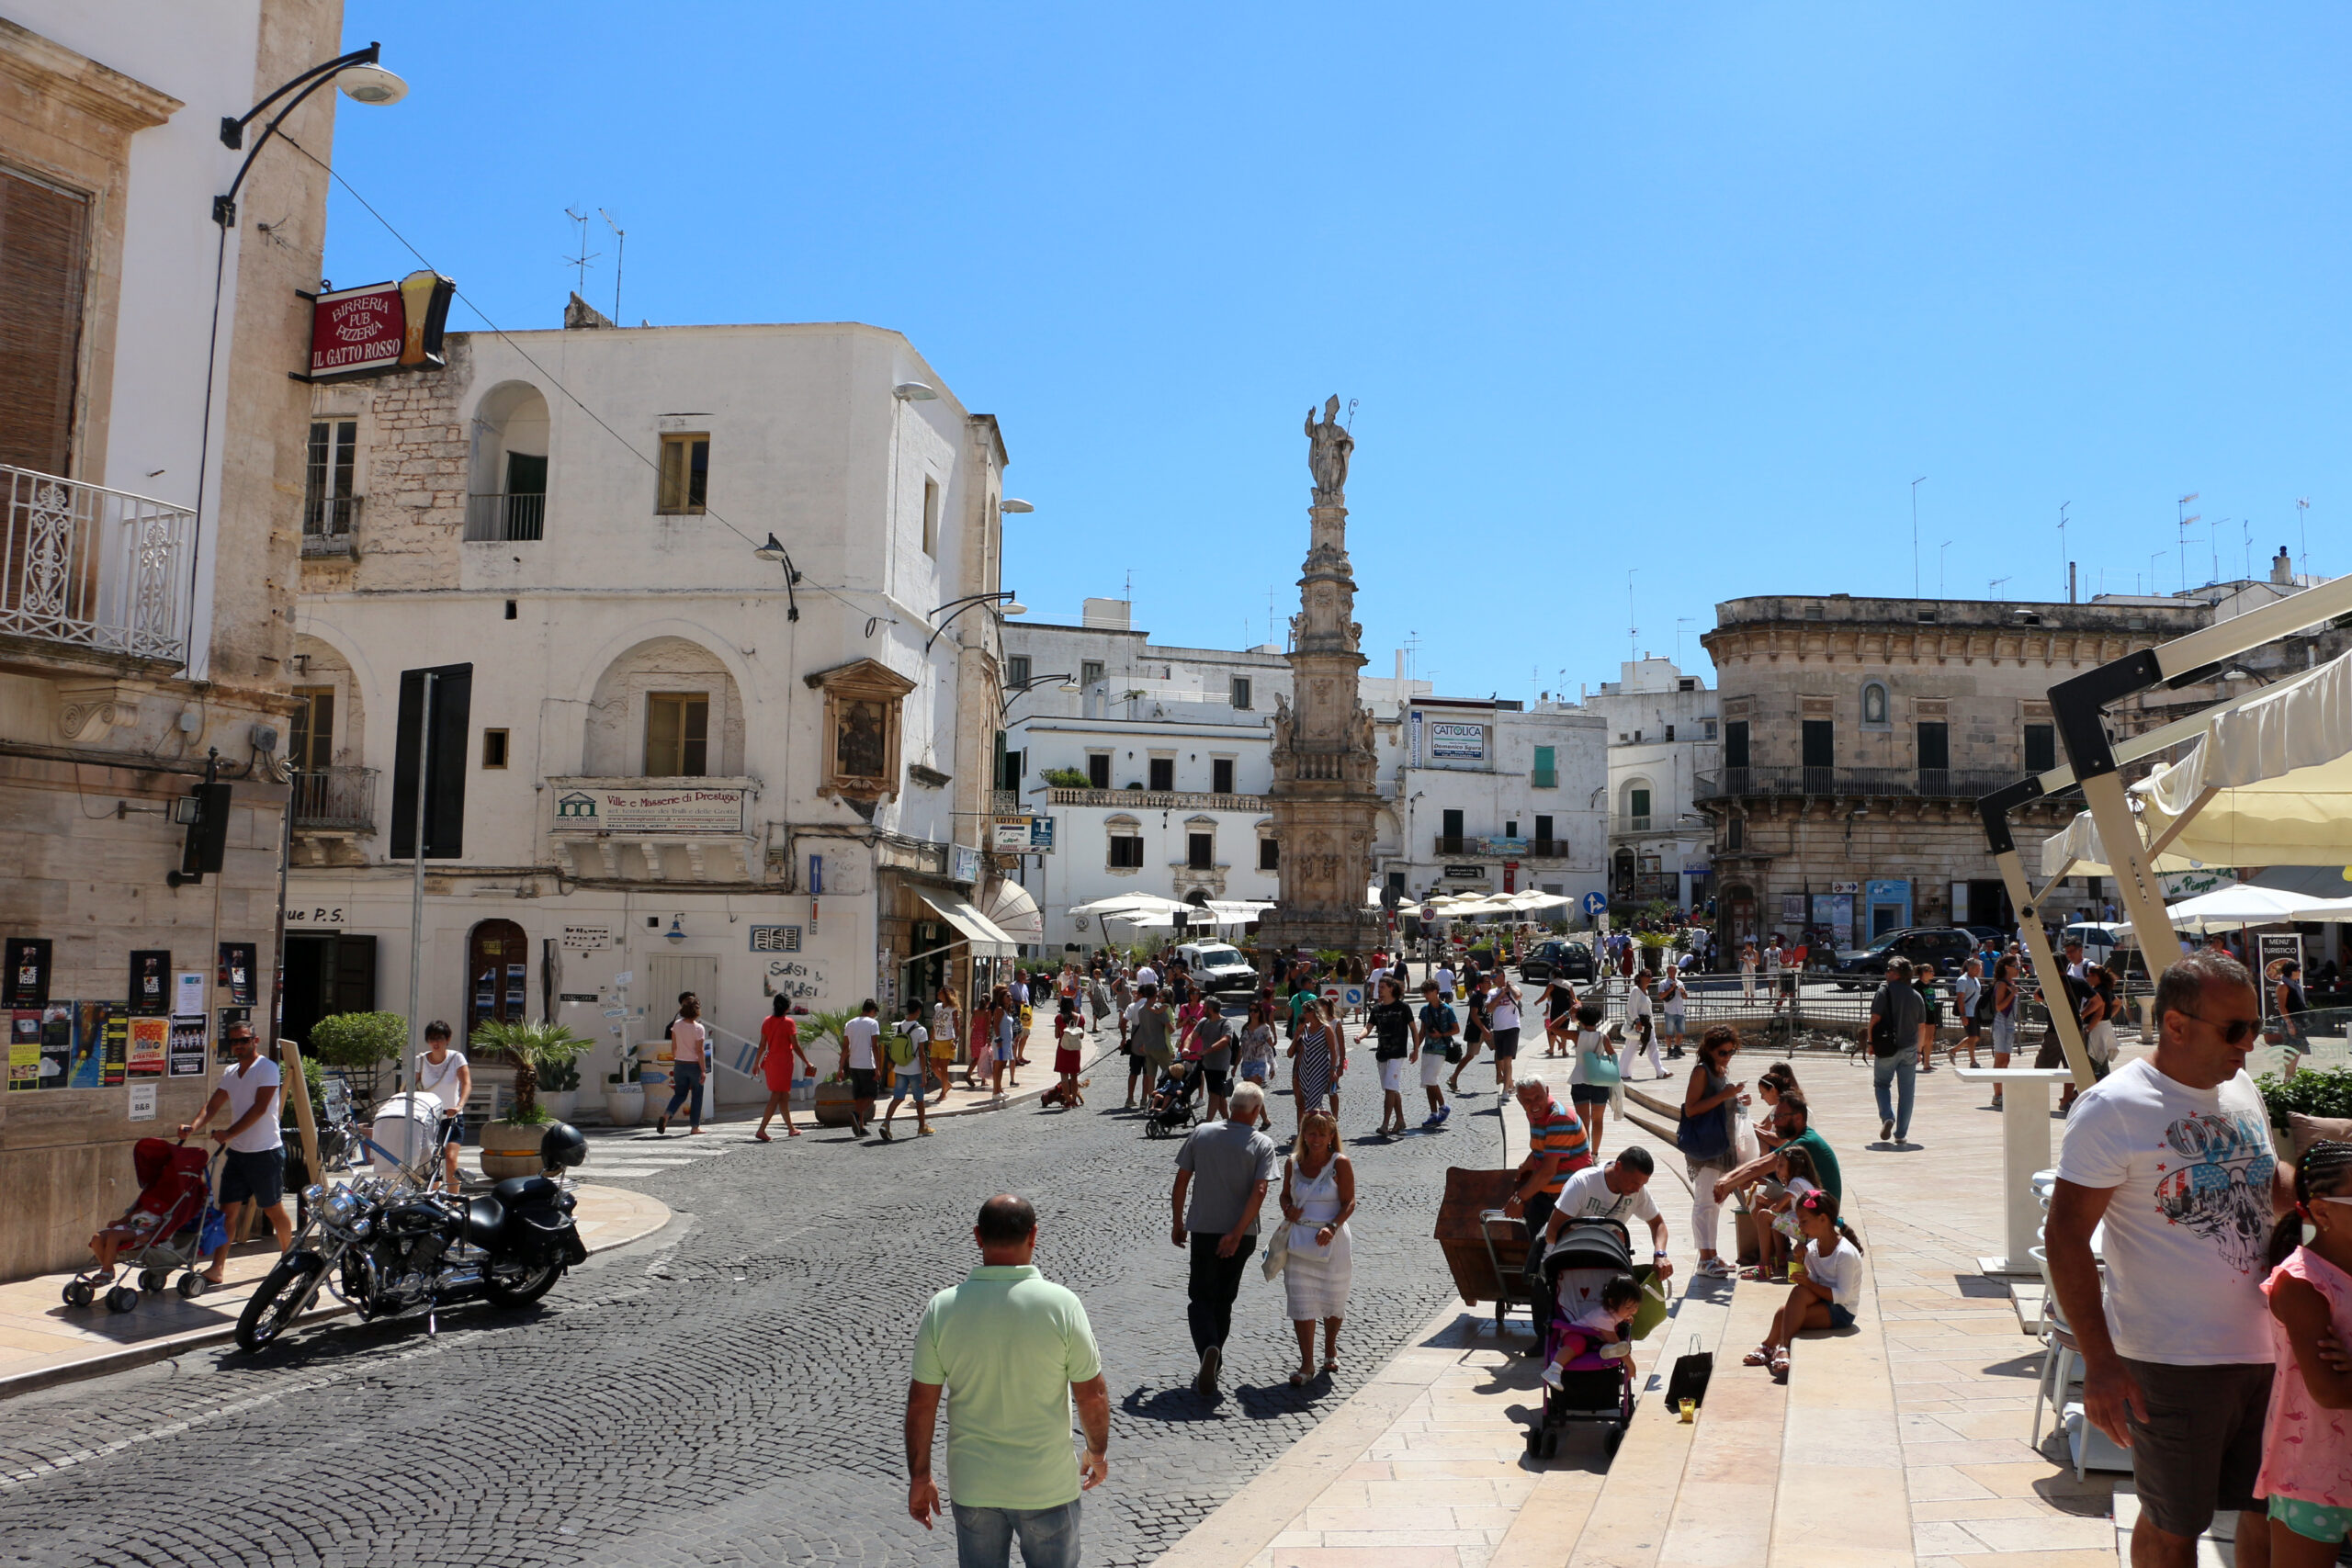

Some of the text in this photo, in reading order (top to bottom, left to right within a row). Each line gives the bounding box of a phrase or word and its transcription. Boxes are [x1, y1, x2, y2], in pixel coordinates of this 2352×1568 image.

[332, 297, 389, 322] BIRRERIA
[349, 311, 370, 327] PUB
[335, 321, 383, 342] PIZZERIA
[313, 338, 401, 367] IL GATTO ROSSO
[1433, 725, 1482, 737] CATTOLICA
[607, 795, 627, 807] Ville
[640, 795, 680, 807] Masserie
[682, 794, 692, 802] di
[695, 792, 740, 804] Prestigio
[1035, 818, 1051, 833] T
[2170, 875, 2219, 895] in Piazza
[286, 908, 345, 922] ue P.S.
[18, 975, 37, 984] VEGA
[143, 984, 160, 993] VEGA
